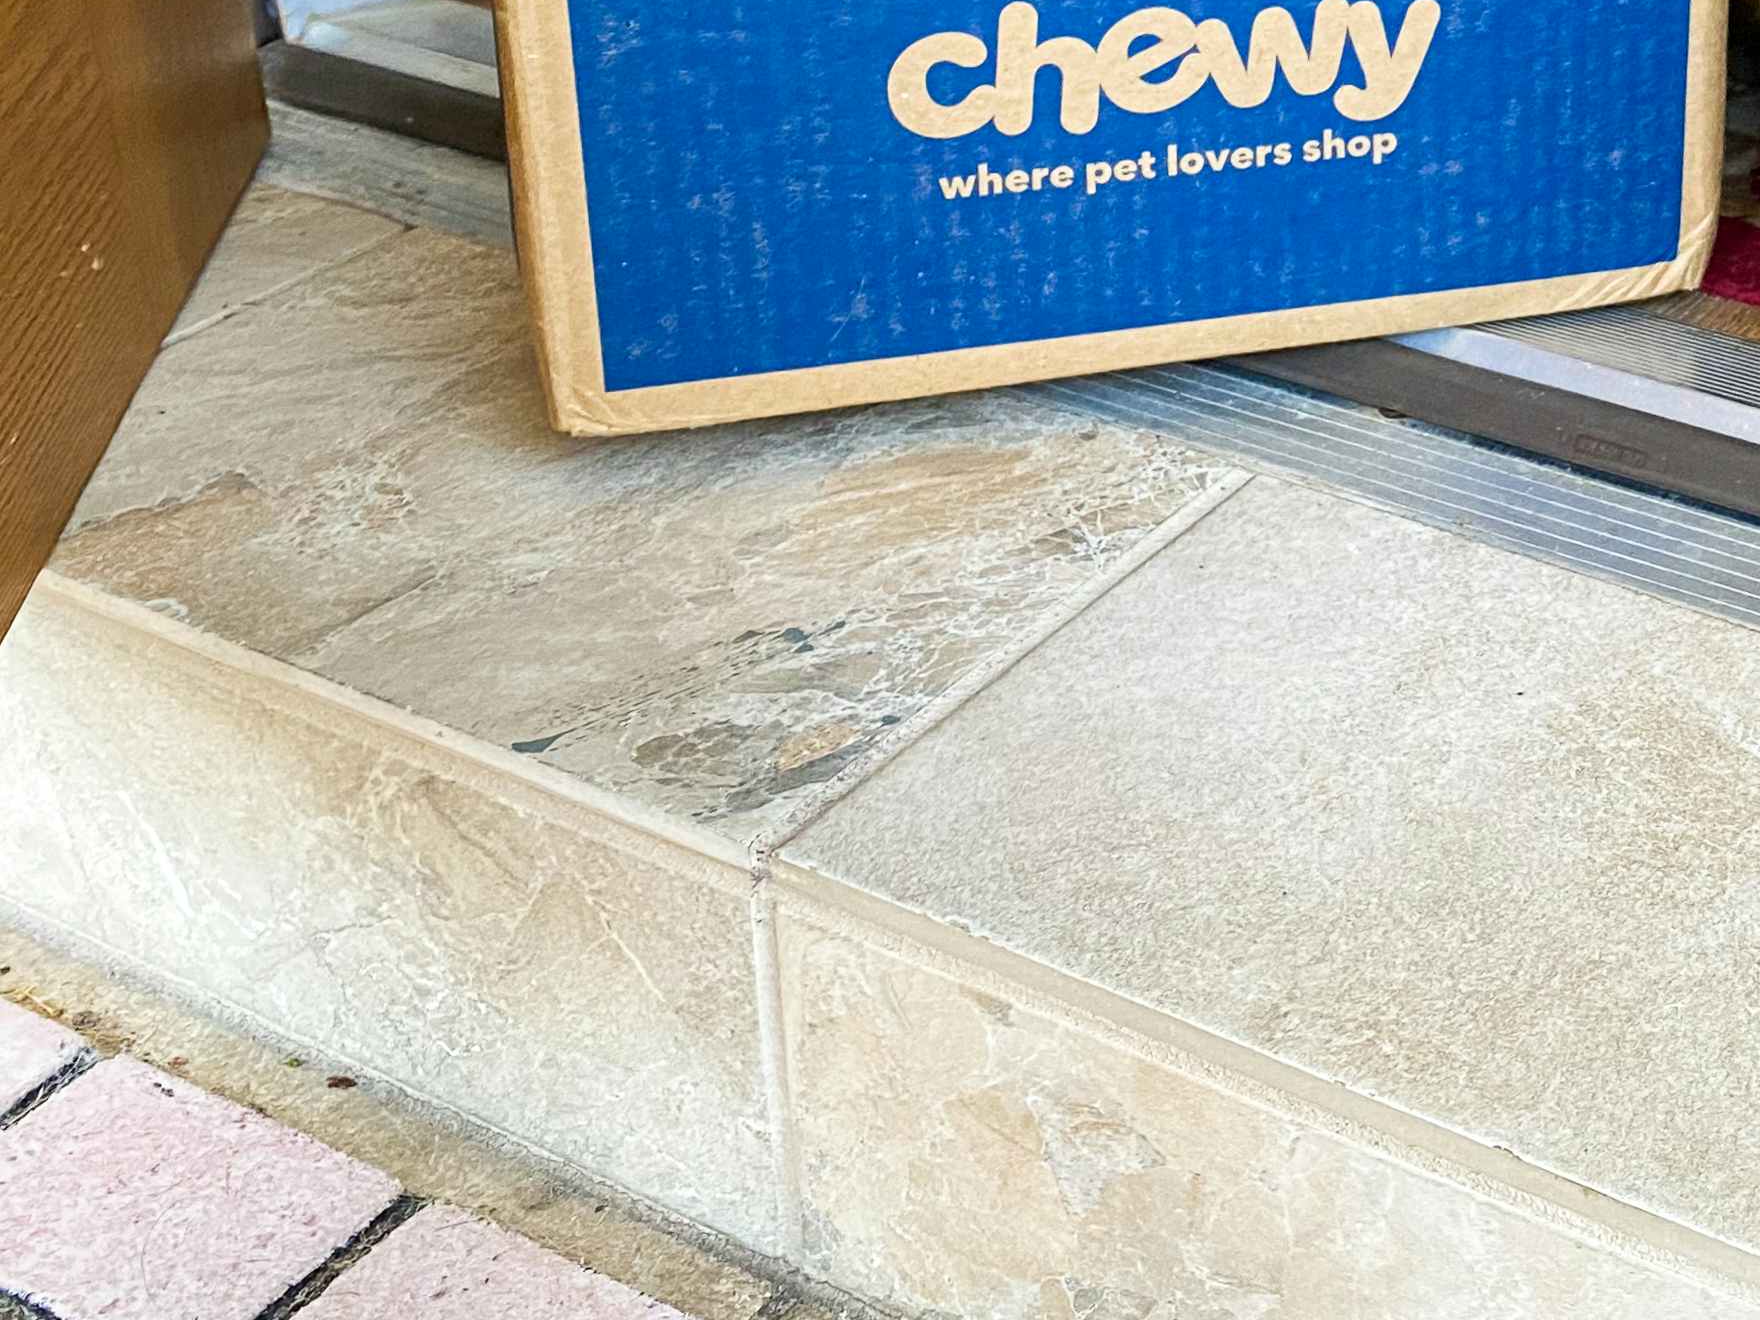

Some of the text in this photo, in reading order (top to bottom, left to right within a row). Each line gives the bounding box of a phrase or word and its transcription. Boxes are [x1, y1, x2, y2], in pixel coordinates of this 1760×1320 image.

[939, 129, 1398, 200] where pet lovers shop
